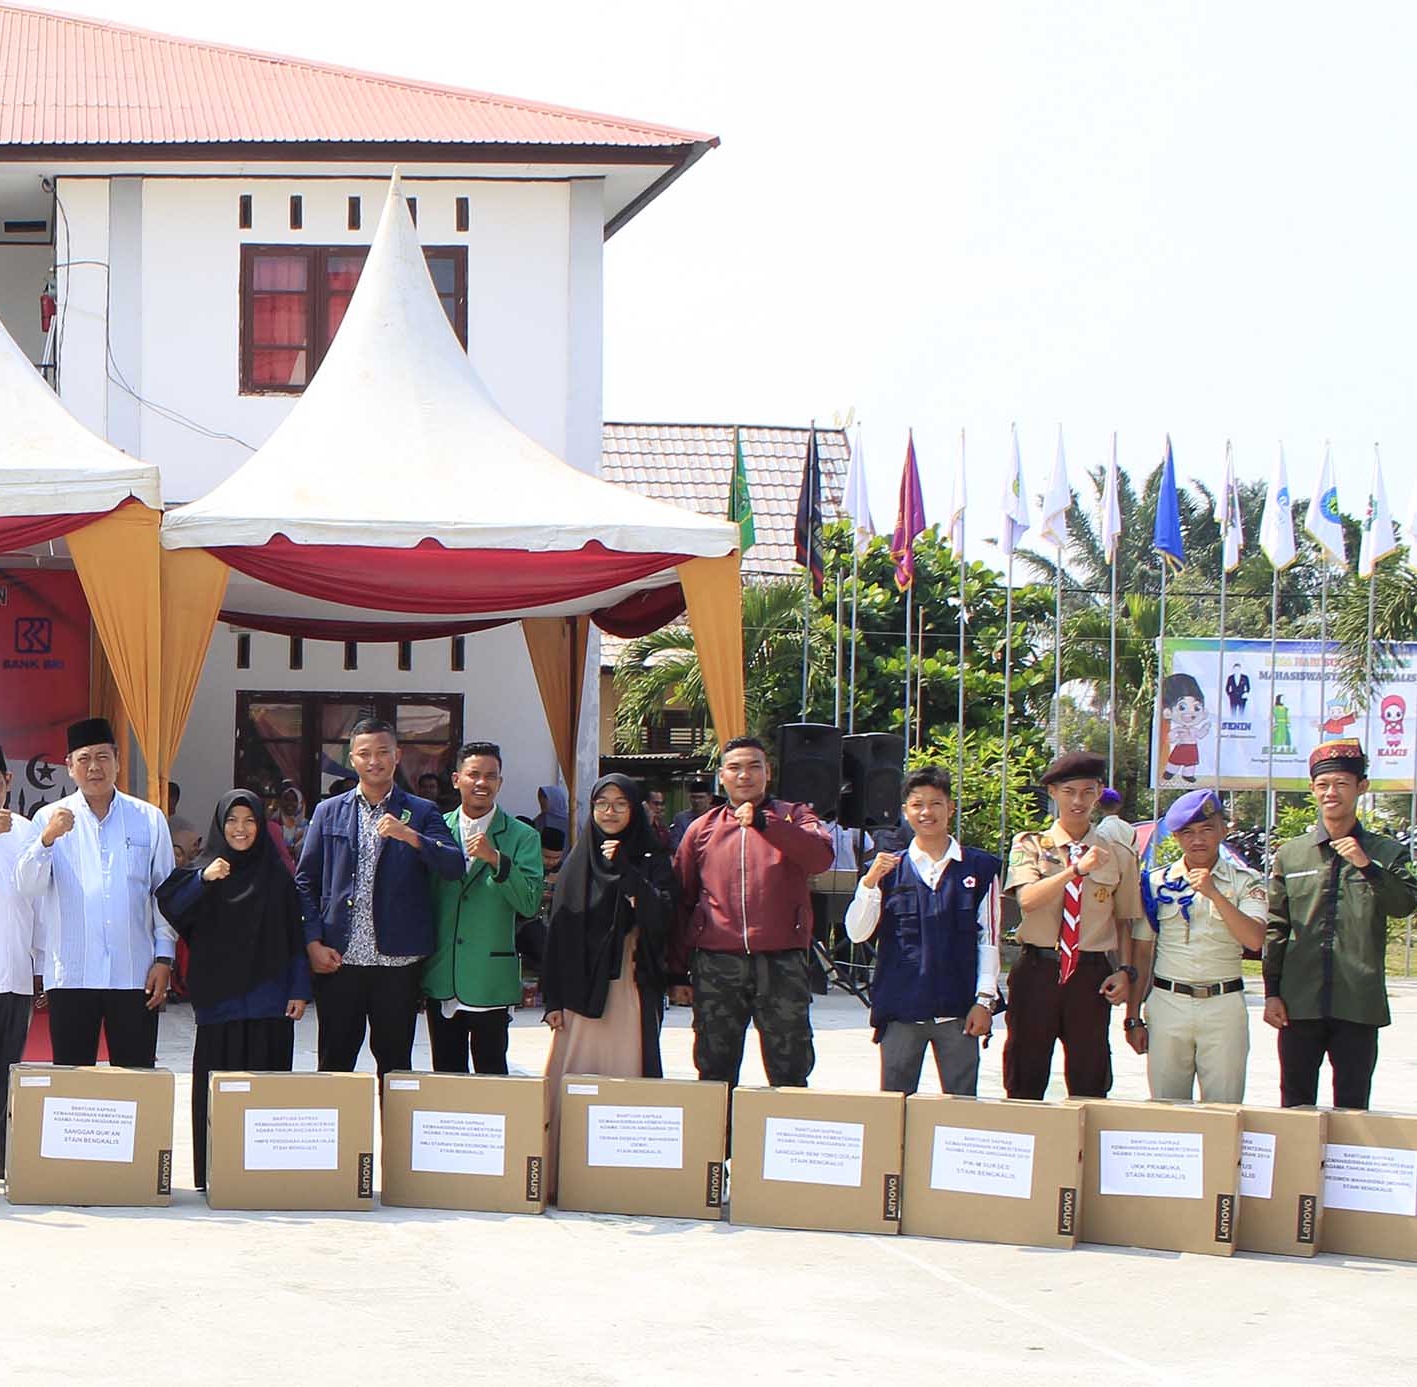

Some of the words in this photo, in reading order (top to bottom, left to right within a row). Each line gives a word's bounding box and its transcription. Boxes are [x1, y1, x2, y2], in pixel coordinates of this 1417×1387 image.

[1221, 722, 1252, 731] SENIN
[160, 1153, 170, 1192] Lenovo
[360, 1156, 371, 1195] Lenovo
[528, 1160, 539, 1199] Lenovo
[709, 1165, 720, 1204] Lenovo
[886, 1177, 897, 1218] Lenovo
[1061, 1191, 1072, 1232] Lenovo
[1218, 1197, 1230, 1240] Lenovo
[1300, 1199, 1312, 1240] Lenovo
